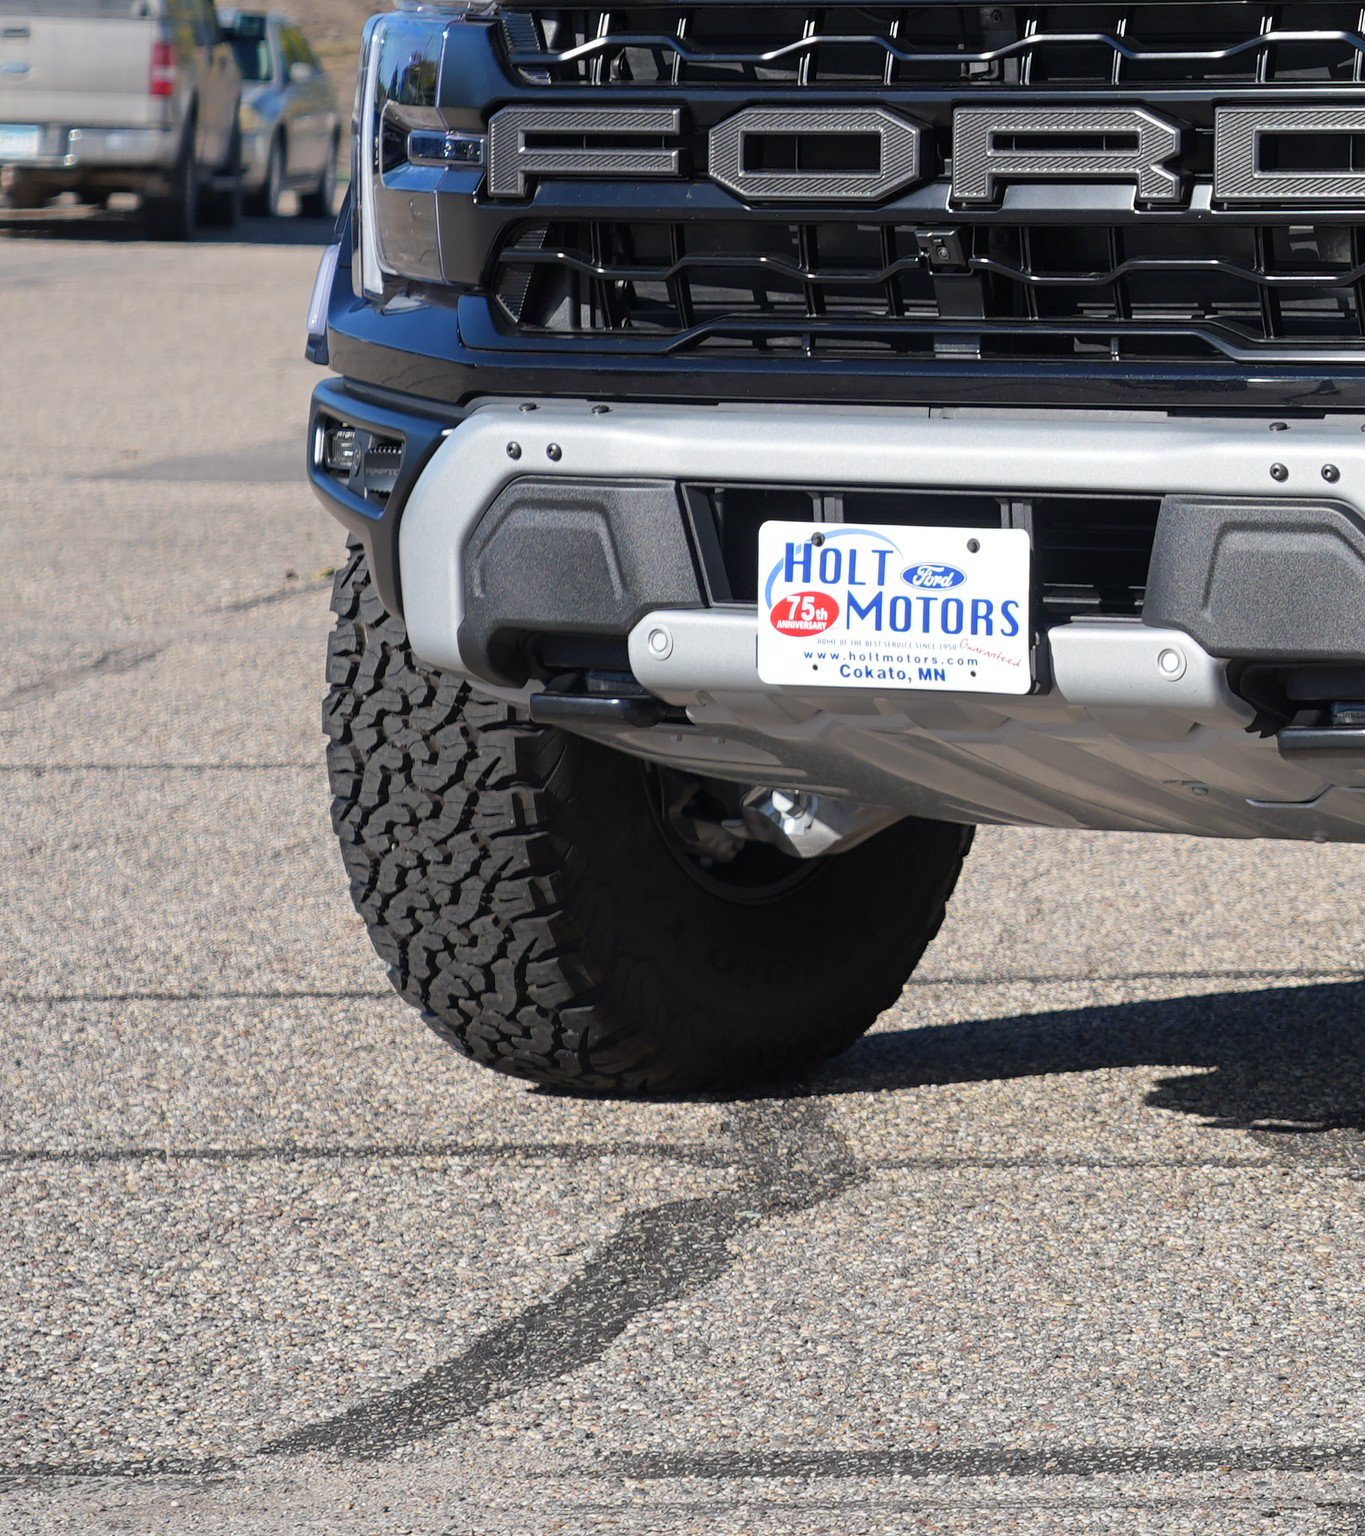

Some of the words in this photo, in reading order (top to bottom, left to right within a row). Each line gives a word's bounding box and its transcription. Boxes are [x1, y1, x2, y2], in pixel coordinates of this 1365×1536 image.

[784, 542, 894, 586] HOLT
[912, 565, 955, 587] Ford
[786, 595, 829, 621] 75th
[846, 590, 1019, 637] MOTORS
[776, 620, 828, 631] ANNIVERSARY
[817, 638, 837, 646] HOME
[850, 639, 862, 647] THE
[865, 640, 881, 648] BEST
[883, 640, 912, 649] SERVICE
[939, 643, 957, 651] 1950
[959, 638, 1021, 668] Guaranteed
[804, 650, 978, 666] www.holtmotors.com
[839, 664, 912, 683] Cokato,
[918, 667, 946, 682] MN
